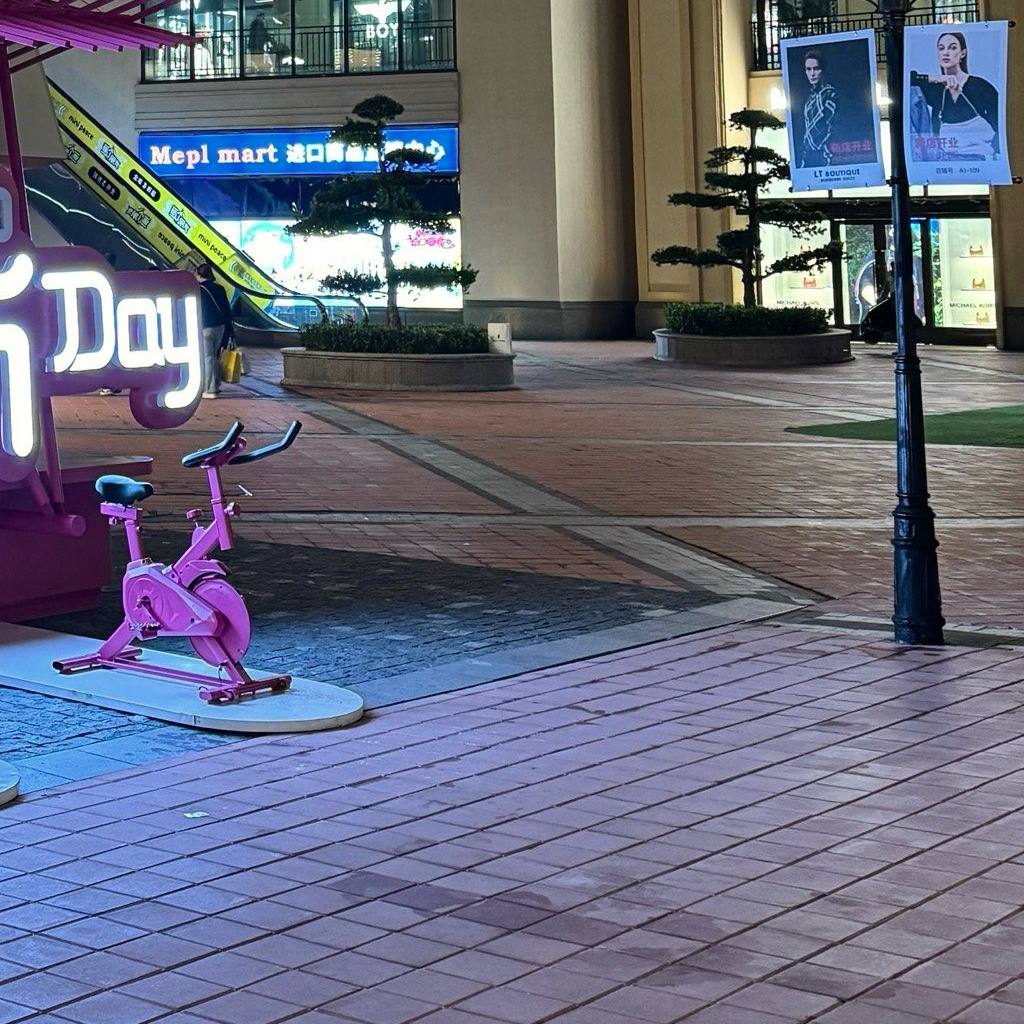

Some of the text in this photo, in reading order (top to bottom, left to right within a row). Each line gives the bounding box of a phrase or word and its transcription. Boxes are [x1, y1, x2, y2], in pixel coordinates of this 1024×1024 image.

[78, 125, 94, 140] peace
[150, 145, 208, 169] Mepl
[218, 144, 277, 163] mart
[210, 244, 227, 262] peace
[41, 260, 202, 410] Day
